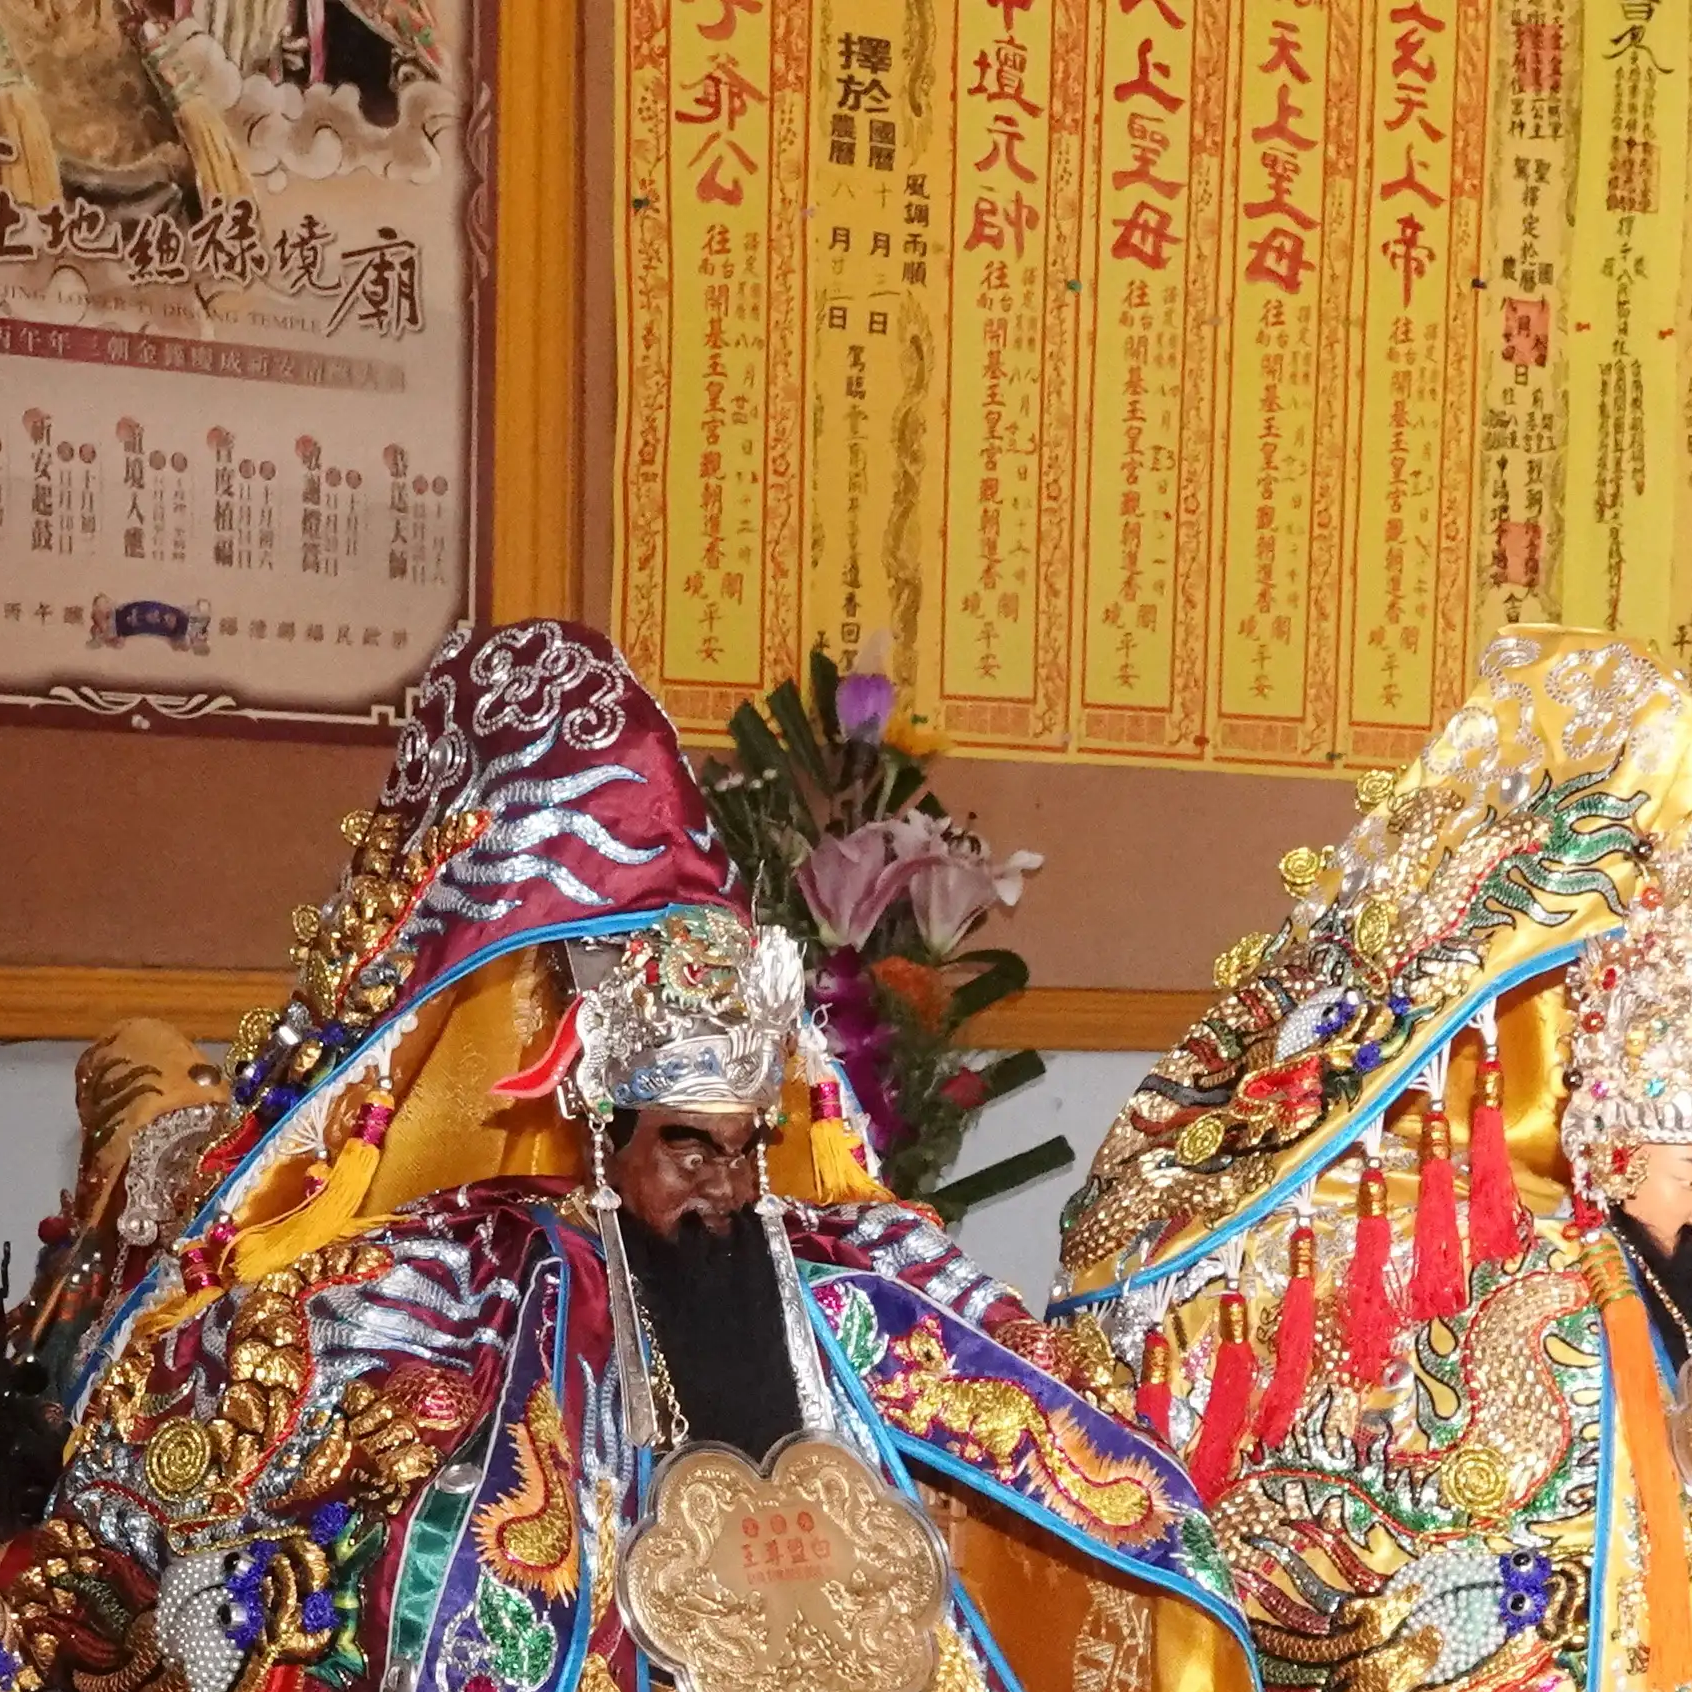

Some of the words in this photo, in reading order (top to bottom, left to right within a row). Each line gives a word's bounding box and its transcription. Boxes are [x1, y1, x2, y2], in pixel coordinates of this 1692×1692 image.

[837, 32, 892, 115] 擇於
[1243, 19, 1322, 295] 天上聖母
